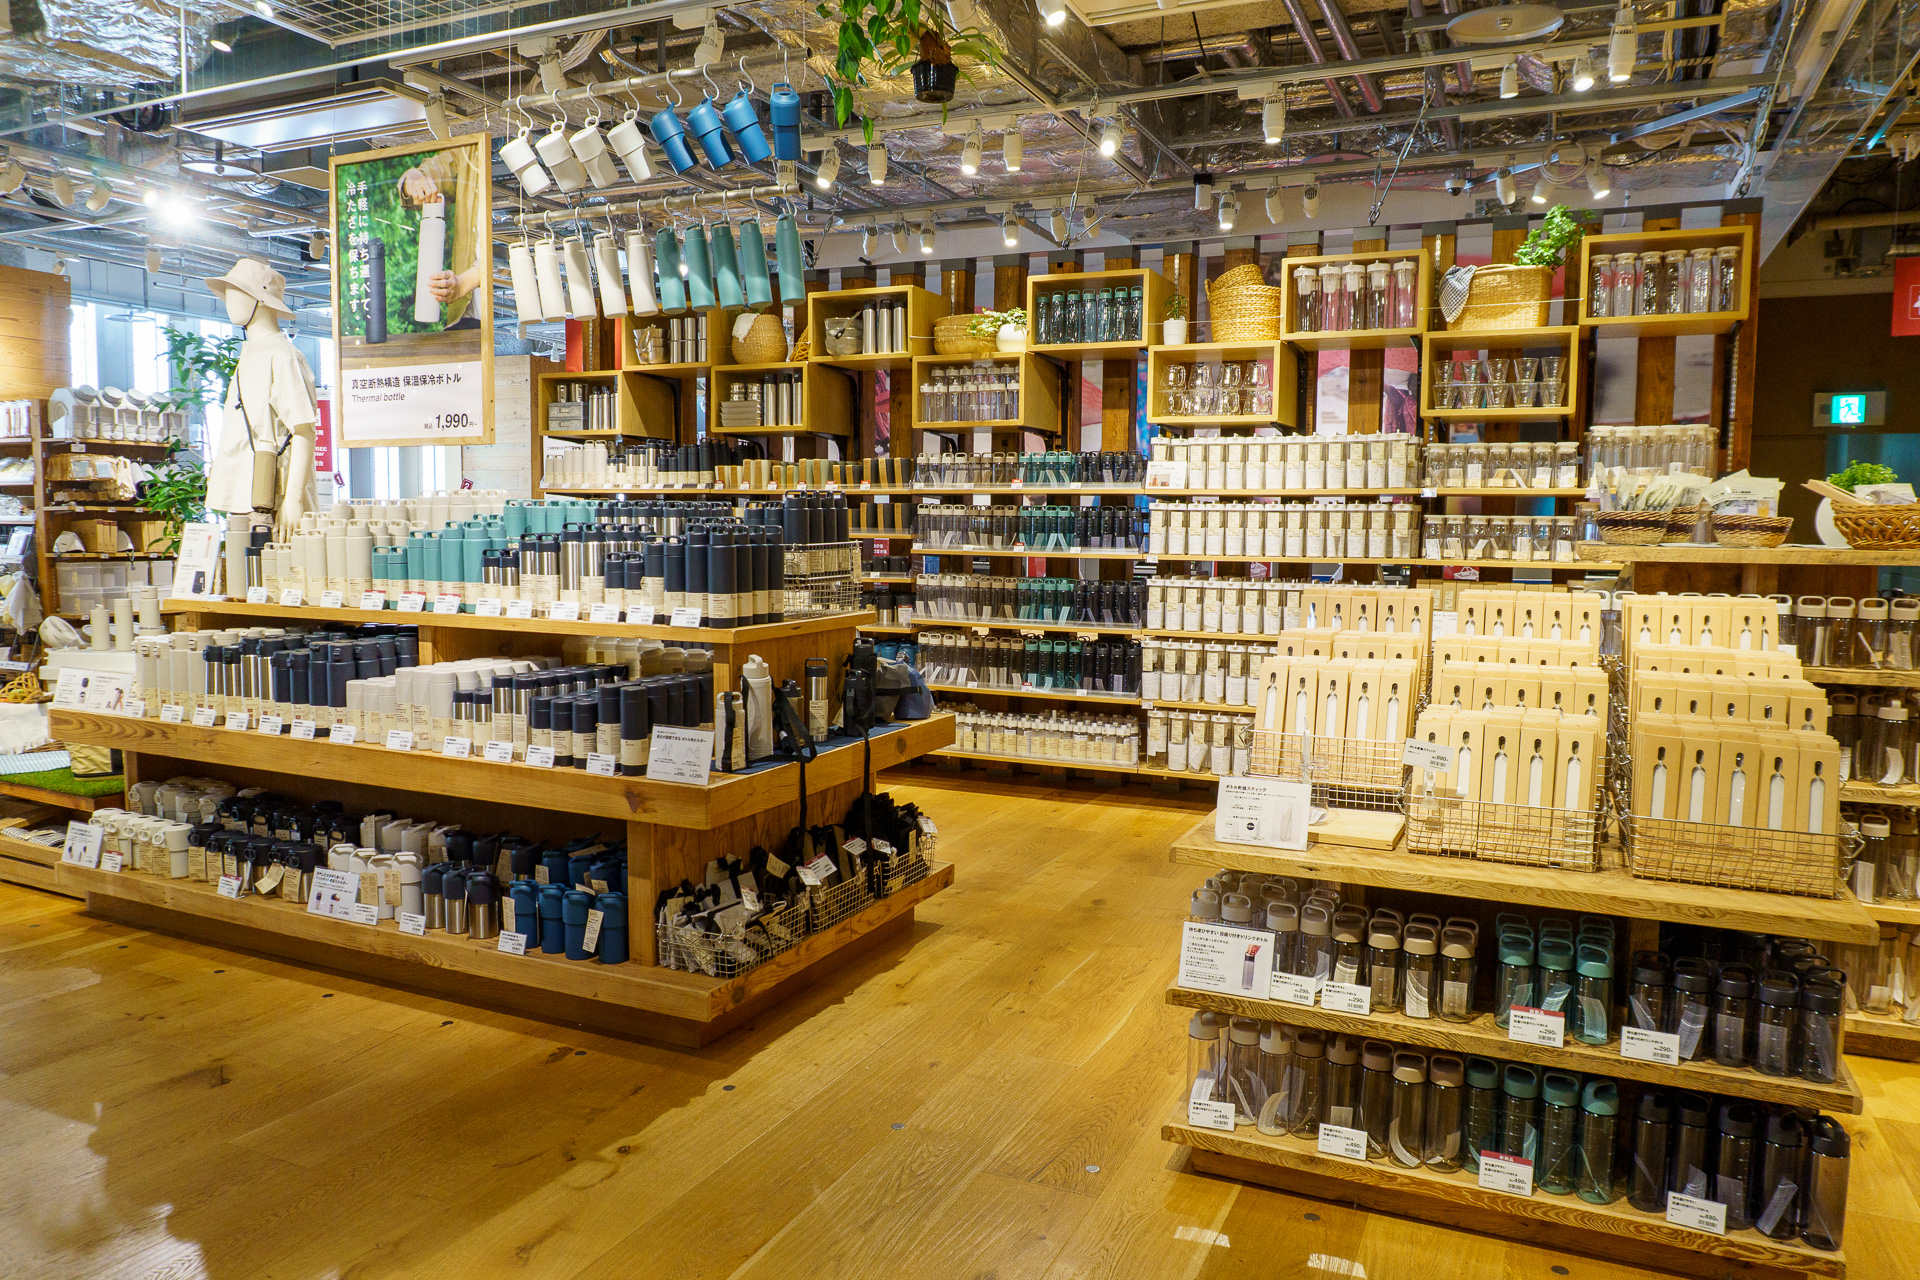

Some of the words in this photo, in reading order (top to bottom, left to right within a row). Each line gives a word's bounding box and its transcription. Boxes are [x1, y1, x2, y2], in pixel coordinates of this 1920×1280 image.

[345, 182, 360, 321] 冷たさを保ちます。
[357, 180, 371, 320] 手軽に持ち運べて、
[351, 376, 401, 389] 真空断熱構造
[403, 373, 462, 387] 保温保冷ボトル
[352, 393, 382, 402] Thermal
[384, 392, 405, 401] bottle
